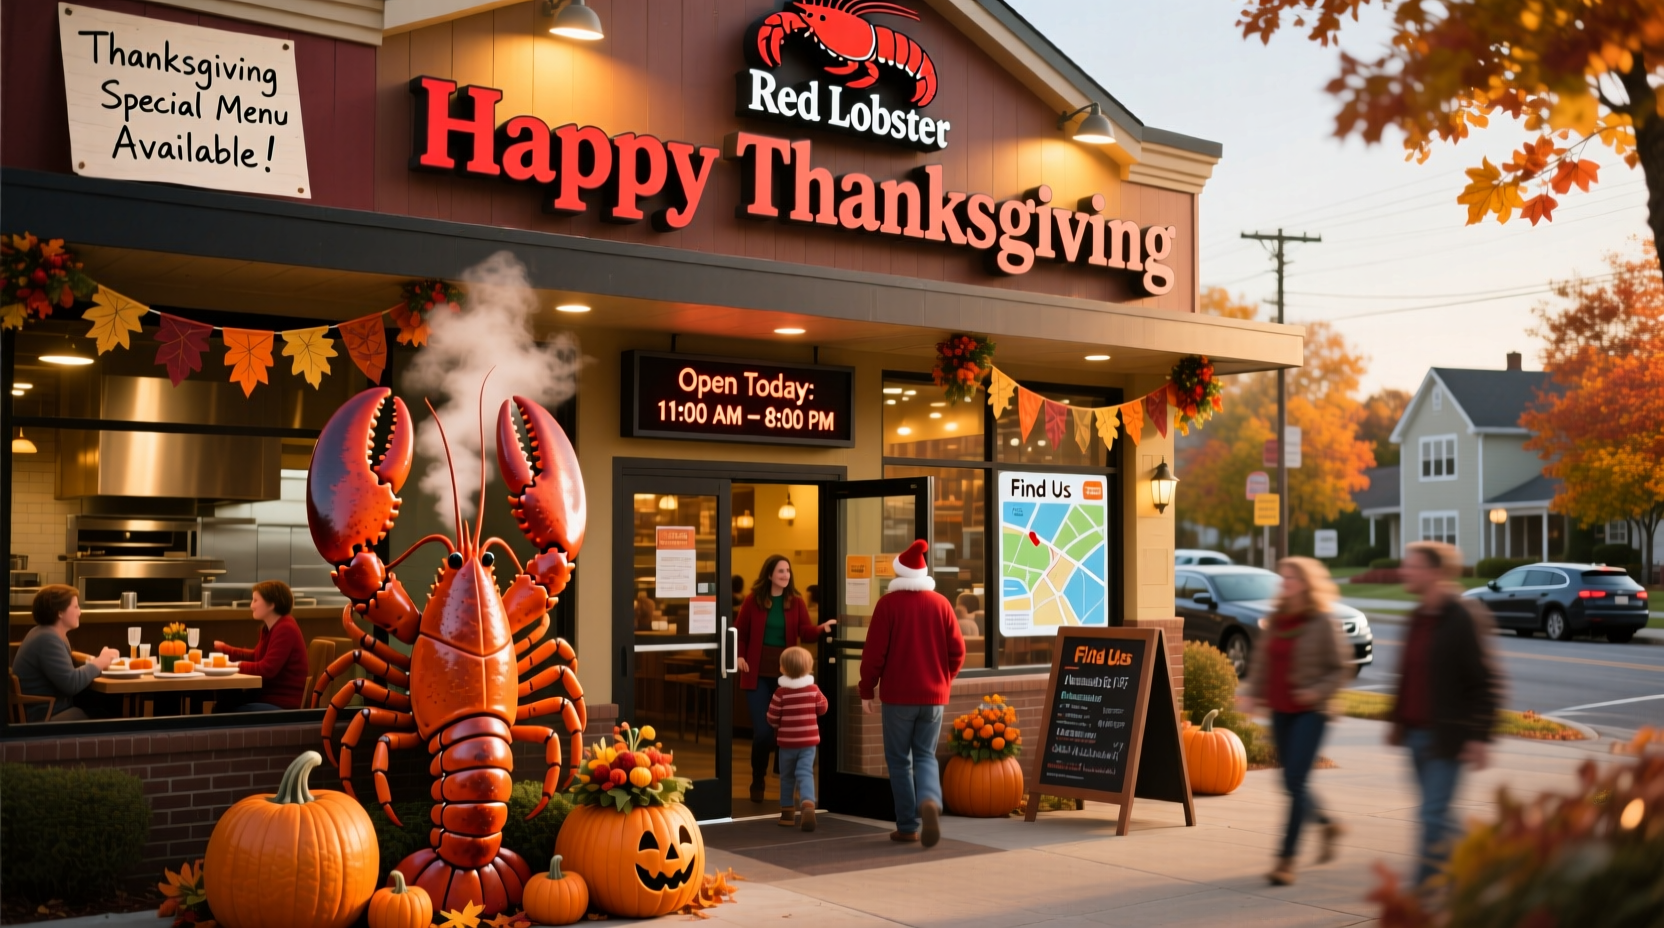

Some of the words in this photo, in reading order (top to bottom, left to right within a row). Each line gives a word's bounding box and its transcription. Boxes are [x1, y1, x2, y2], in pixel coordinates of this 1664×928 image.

[78, 30, 278, 98] Thanksgiving
[100, 78, 202, 122] Special
[215, 94, 289, 126] Menu
[748, 68, 821, 122] Red
[828, 86, 951, 149] Lobster
[111, 124, 276, 173] Available!
[419, 76, 721, 230] Happy
[734, 131, 1178, 296] Thanksgiving
[678, 367, 738, 399] Open
[743, 371, 815, 405] Today:
[657, 400, 708, 424] 11:00
[712, 404, 743, 425] AM
[764, 406, 804, 430] 8:00
[808, 410, 835, 431] PM
[1011, 478, 1047, 498] Find
[1052, 479, 1072, 498] Us
